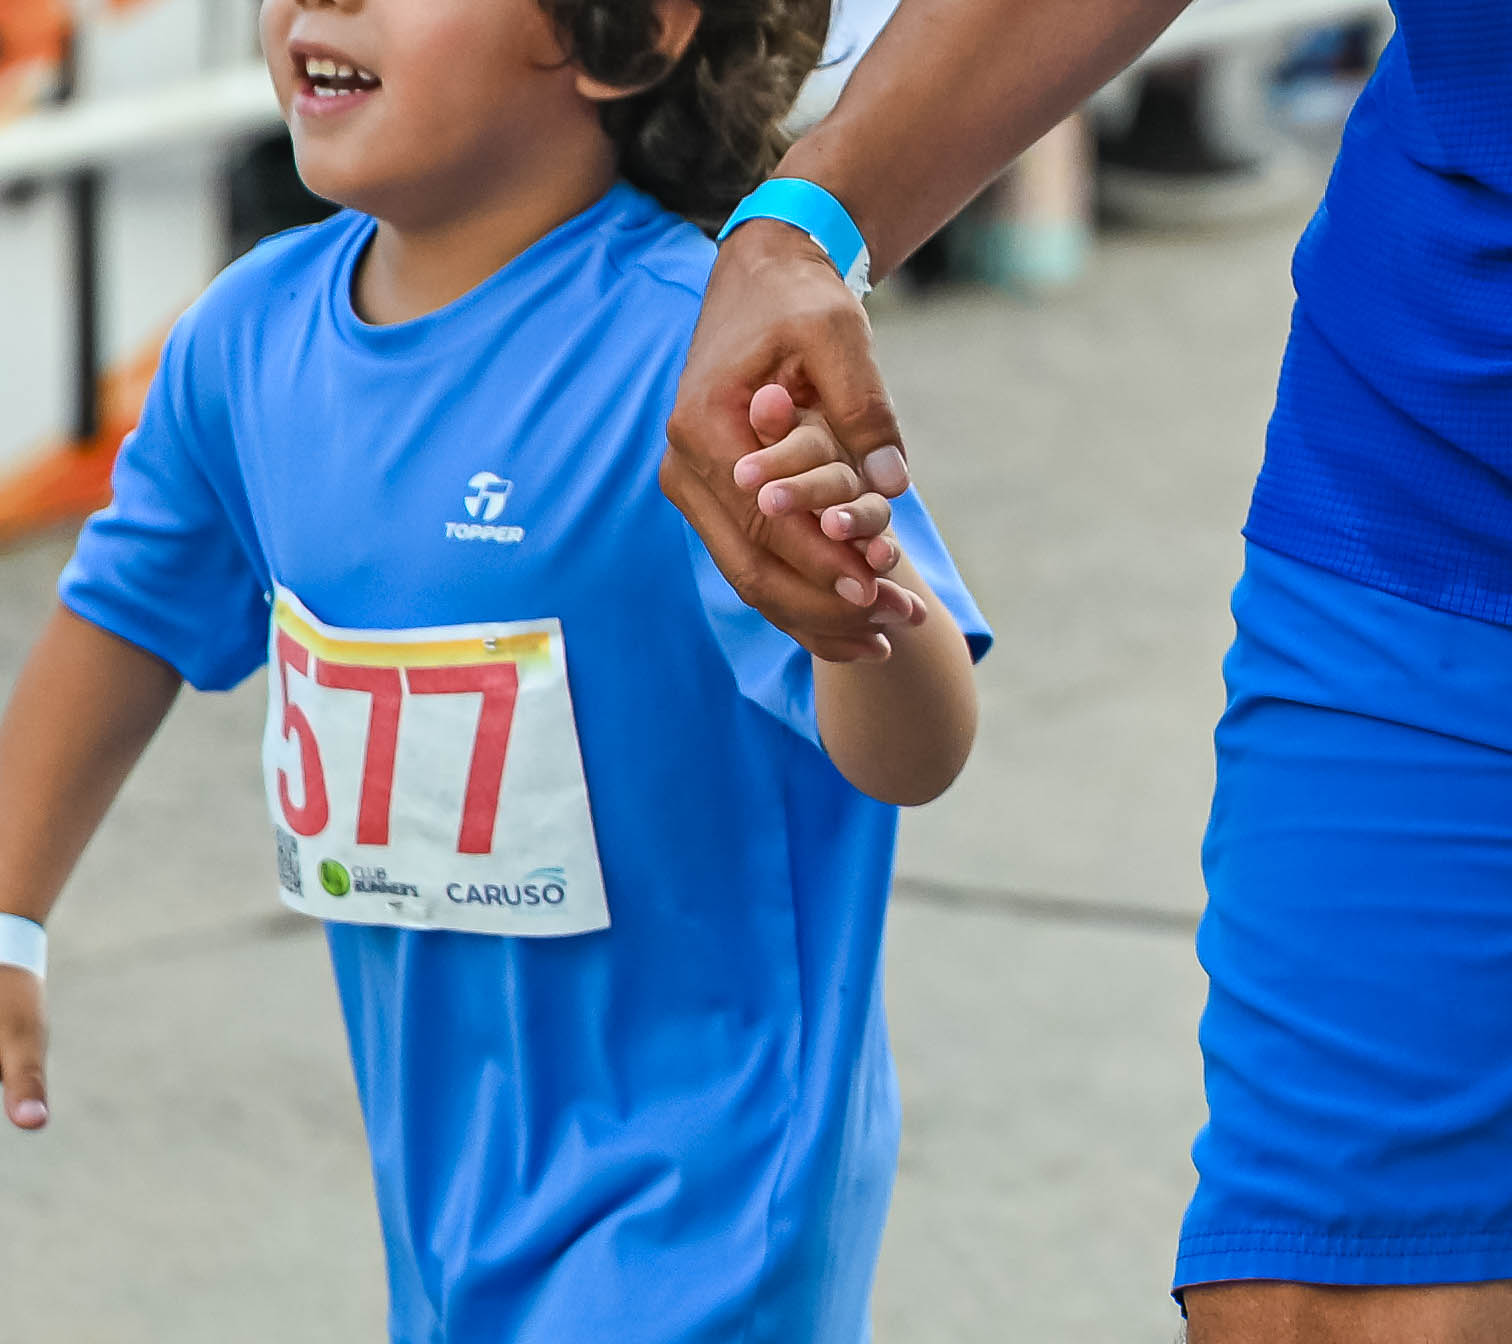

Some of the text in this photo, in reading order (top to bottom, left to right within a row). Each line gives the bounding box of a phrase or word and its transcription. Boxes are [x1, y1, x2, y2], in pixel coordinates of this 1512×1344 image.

[445, 521, 525, 543] TOPPER
[276, 627, 520, 855] 577
[446, 882, 565, 906] CARUSO
